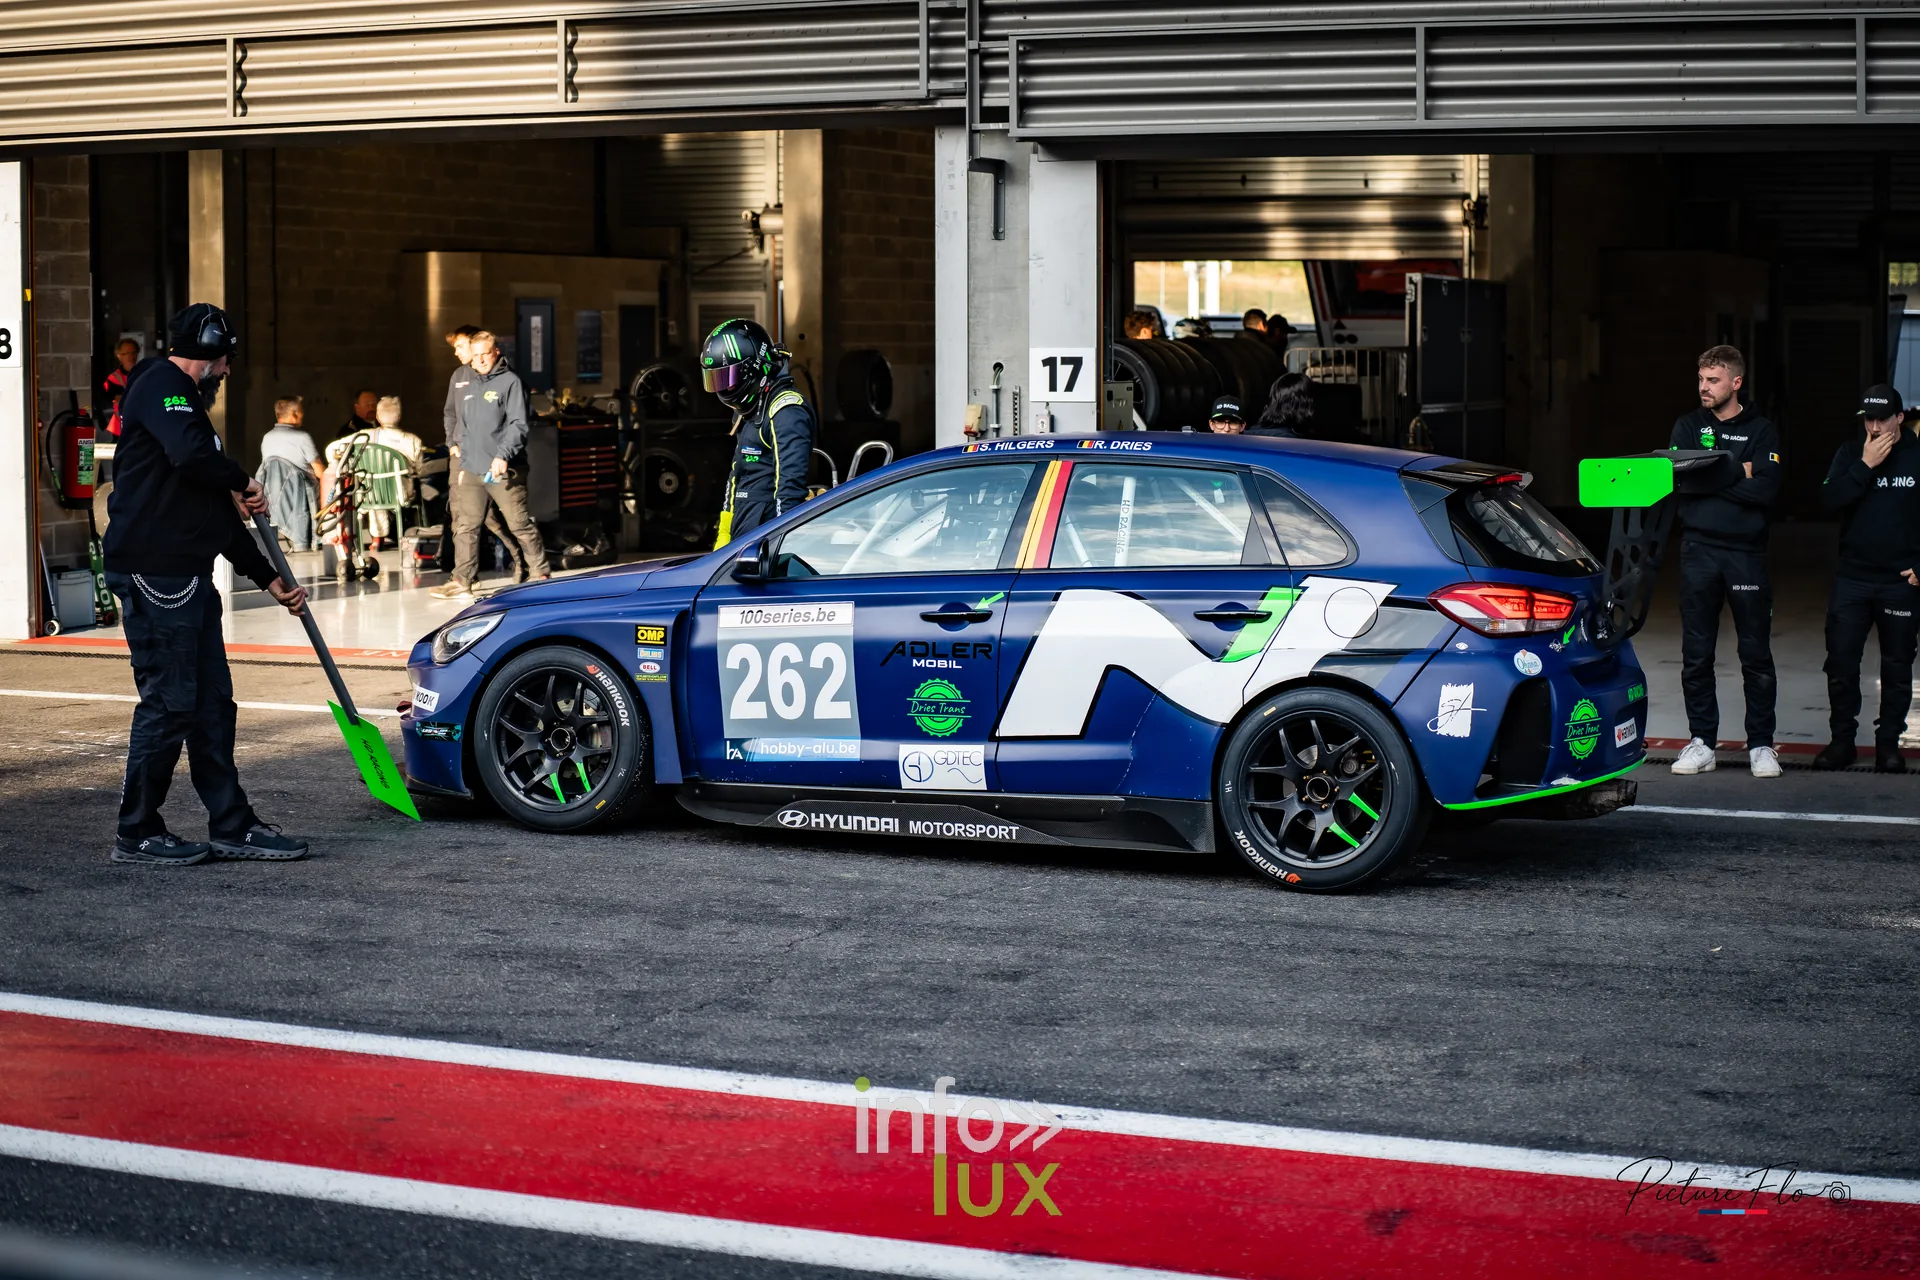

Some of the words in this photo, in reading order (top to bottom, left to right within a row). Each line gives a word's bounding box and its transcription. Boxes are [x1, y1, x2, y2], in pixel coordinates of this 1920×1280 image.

[1041, 356, 1084, 392] 17
[163, 396, 188, 407] 262
[979, 443, 992, 452] S.
[994, 440, 1055, 451] HILGERS
[1093, 440, 1107, 450] R.
[1110, 441, 1152, 451] DRIES
[1877, 476, 1915, 488] AING
[1121, 499, 1131, 514] HD
[1116, 517, 1129, 555] RACING
[740, 607, 836, 625] 100series.be
[637, 629, 665, 641] OMP
[879, 641, 993, 667] ADLER
[912, 659, 963, 669] MOBIL
[726, 642, 852, 721] 262
[415, 692, 435, 707] KOOK
[911, 700, 936, 713] Dries
[938, 702, 966, 714] Trans
[1567, 725, 1585, 739] Dries
[760, 742, 857, 757] hobby-alu.be
[933, 750, 983, 767] GDTEC
[367, 753, 390, 789] RACING
[810, 812, 900, 834] HYUNDAI
[908, 820, 1019, 840] MOTORSPORT
